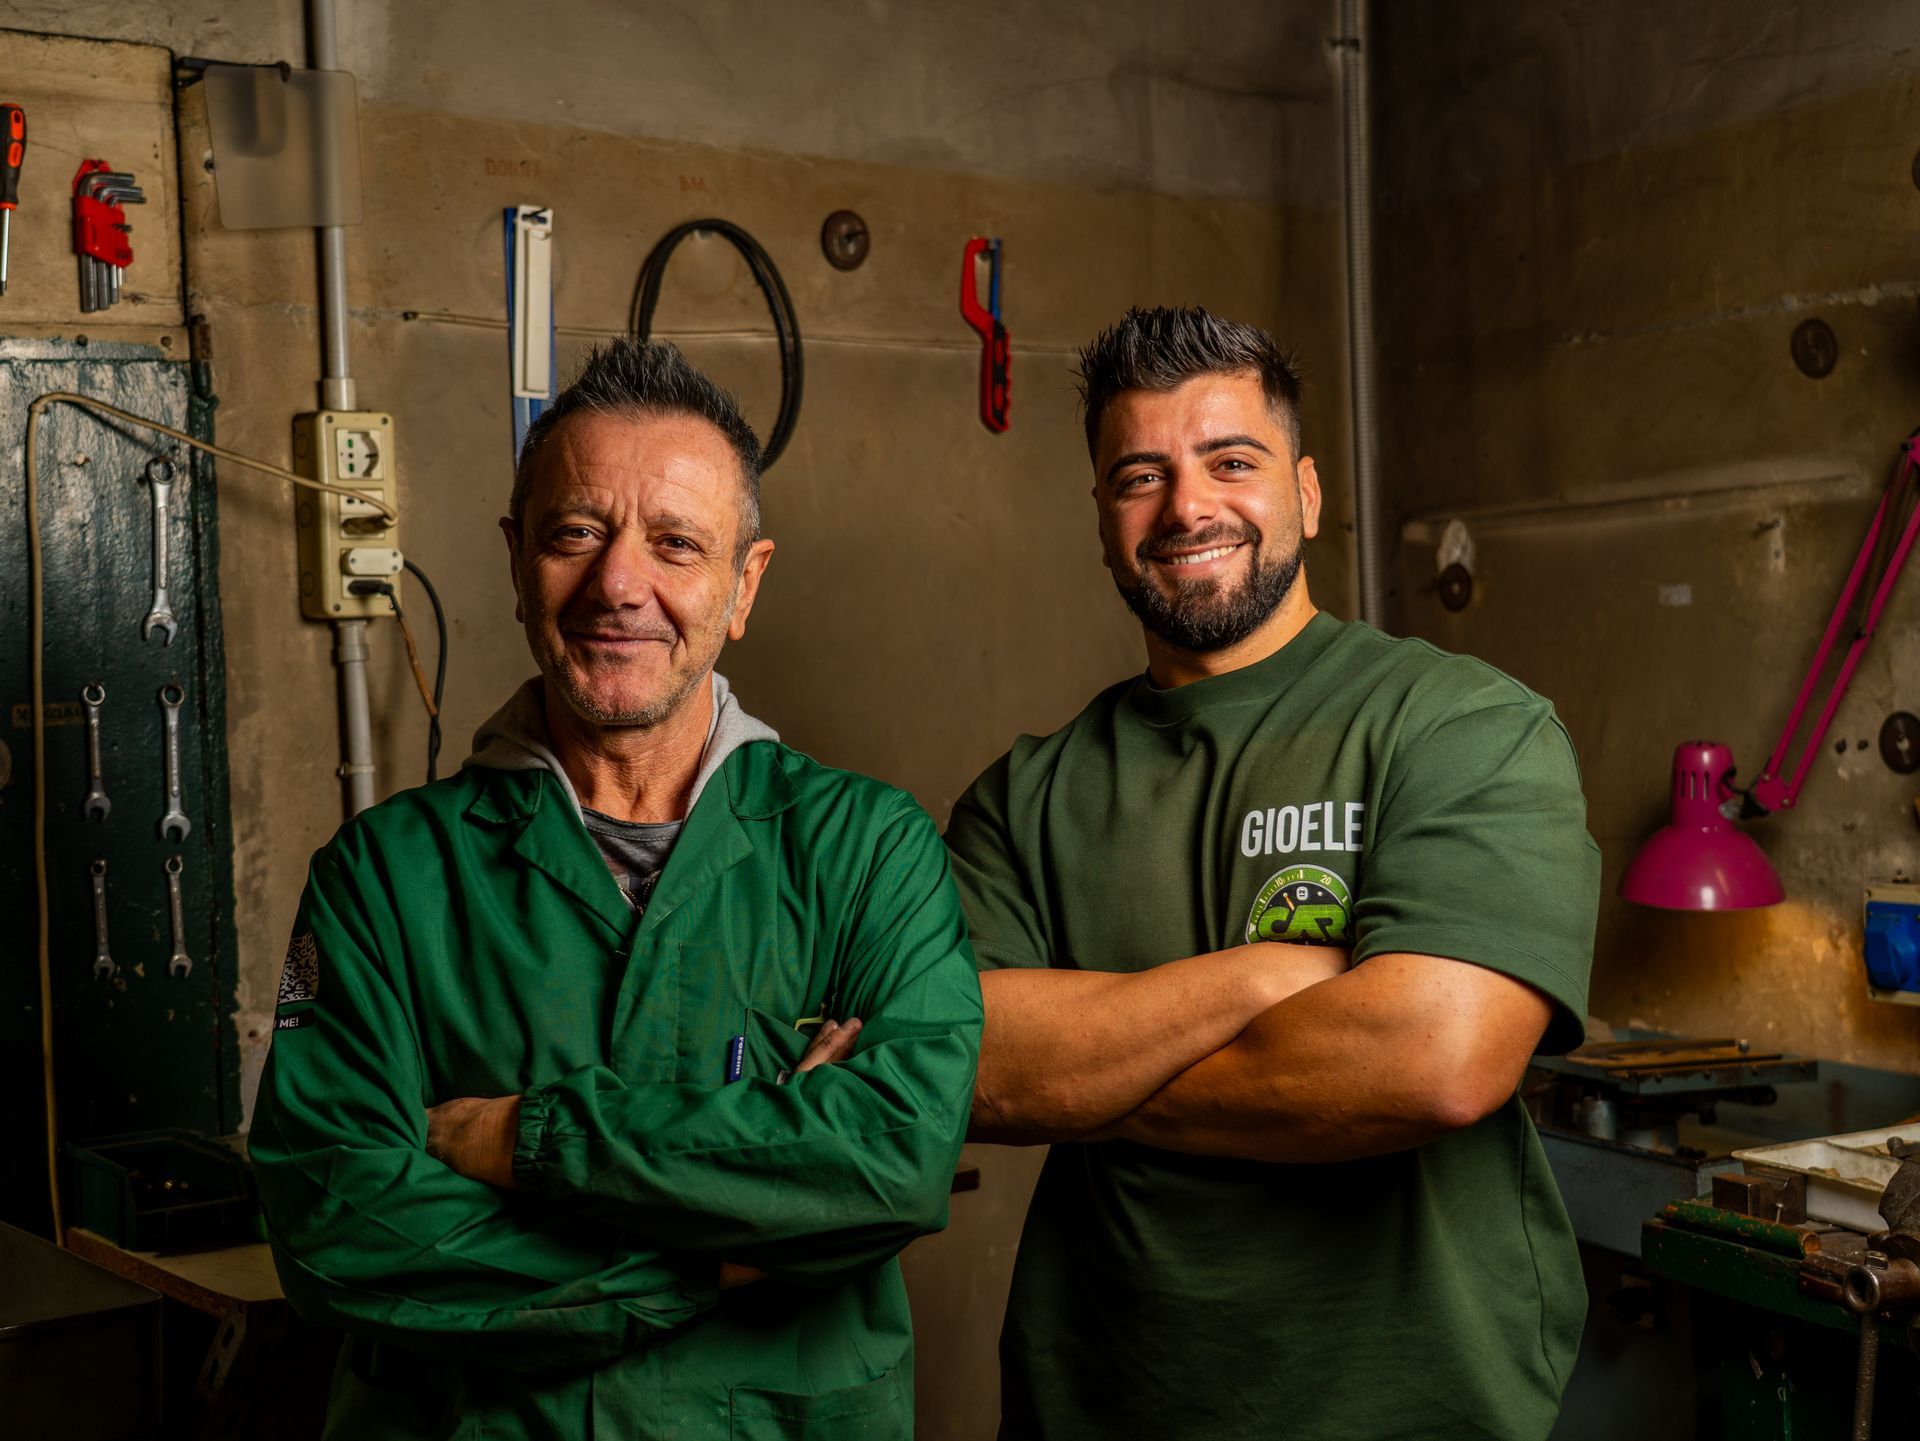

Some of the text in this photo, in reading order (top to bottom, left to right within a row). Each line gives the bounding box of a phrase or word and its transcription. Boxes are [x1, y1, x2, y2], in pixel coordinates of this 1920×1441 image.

[1240, 801, 1365, 858] GIOELE
[1320, 874, 1332, 885] 20
[279, 1016, 299, 1028] ME!
